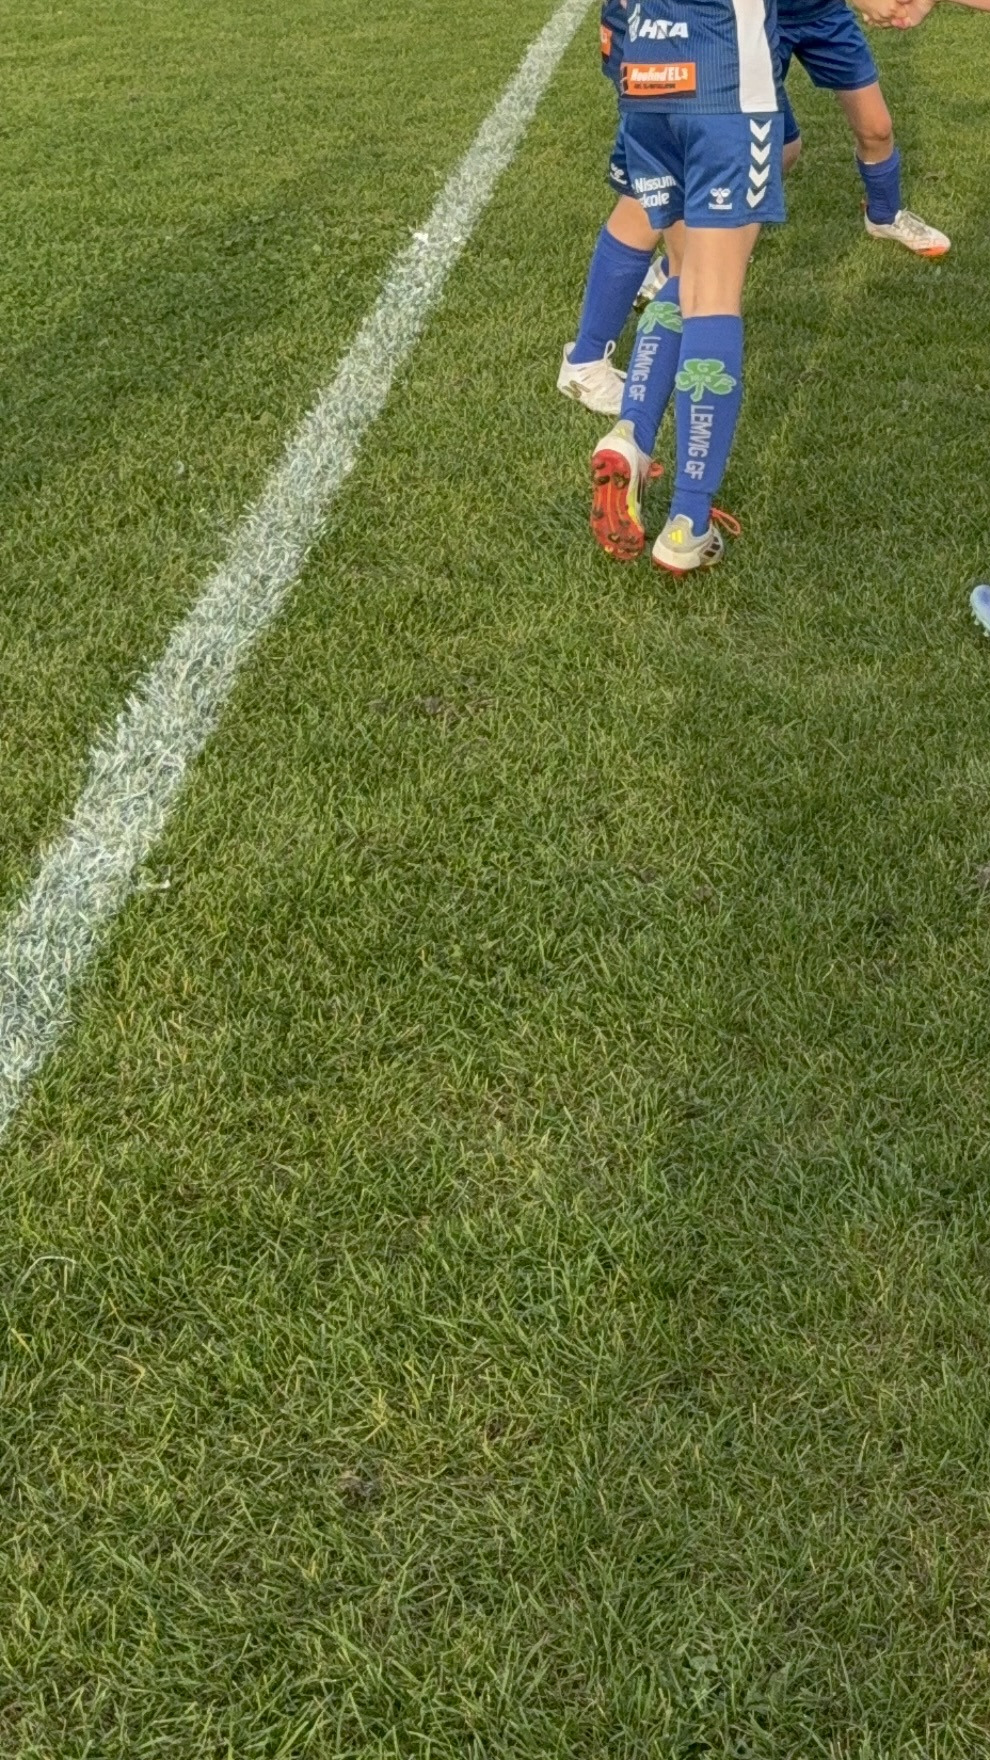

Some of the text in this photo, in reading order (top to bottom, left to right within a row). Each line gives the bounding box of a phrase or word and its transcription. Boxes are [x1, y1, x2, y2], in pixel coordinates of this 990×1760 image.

[635, 175, 677, 193] Nissum
[628, 335, 661, 403] LEMVIG GF
[688, 404, 714, 458] LEMVIG
[684, 459, 706, 481] GF
